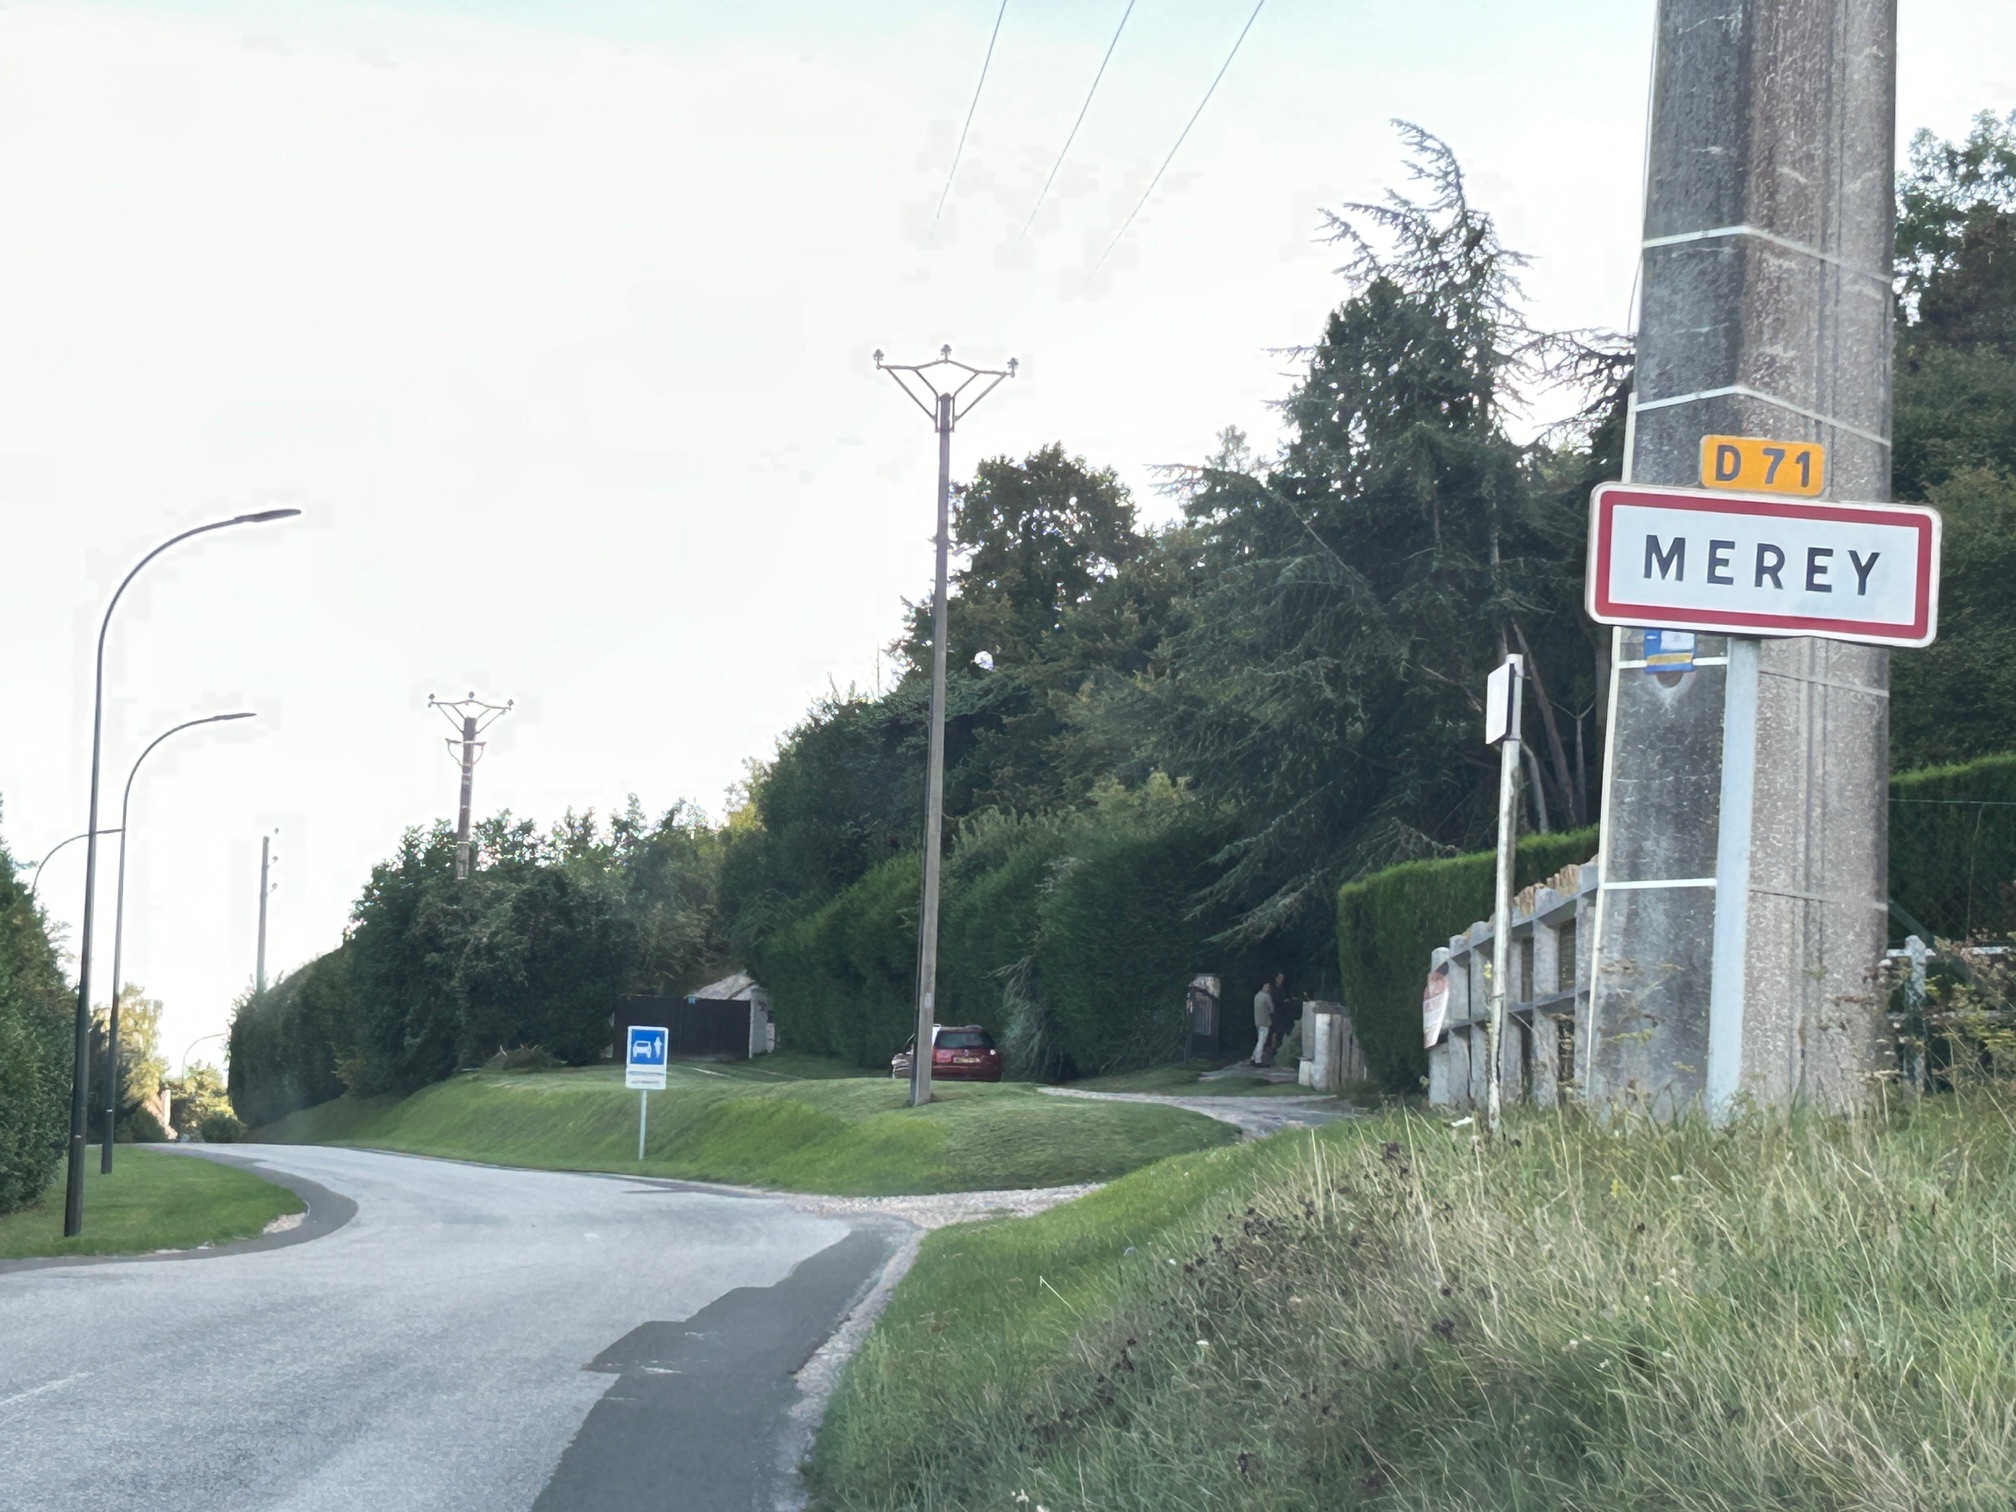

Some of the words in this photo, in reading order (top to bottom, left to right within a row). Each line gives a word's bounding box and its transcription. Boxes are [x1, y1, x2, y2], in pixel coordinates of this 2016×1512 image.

[1715, 445, 1741, 481] D
[1763, 448, 1810, 487] 71
[1643, 534, 1880, 595] MEREY
